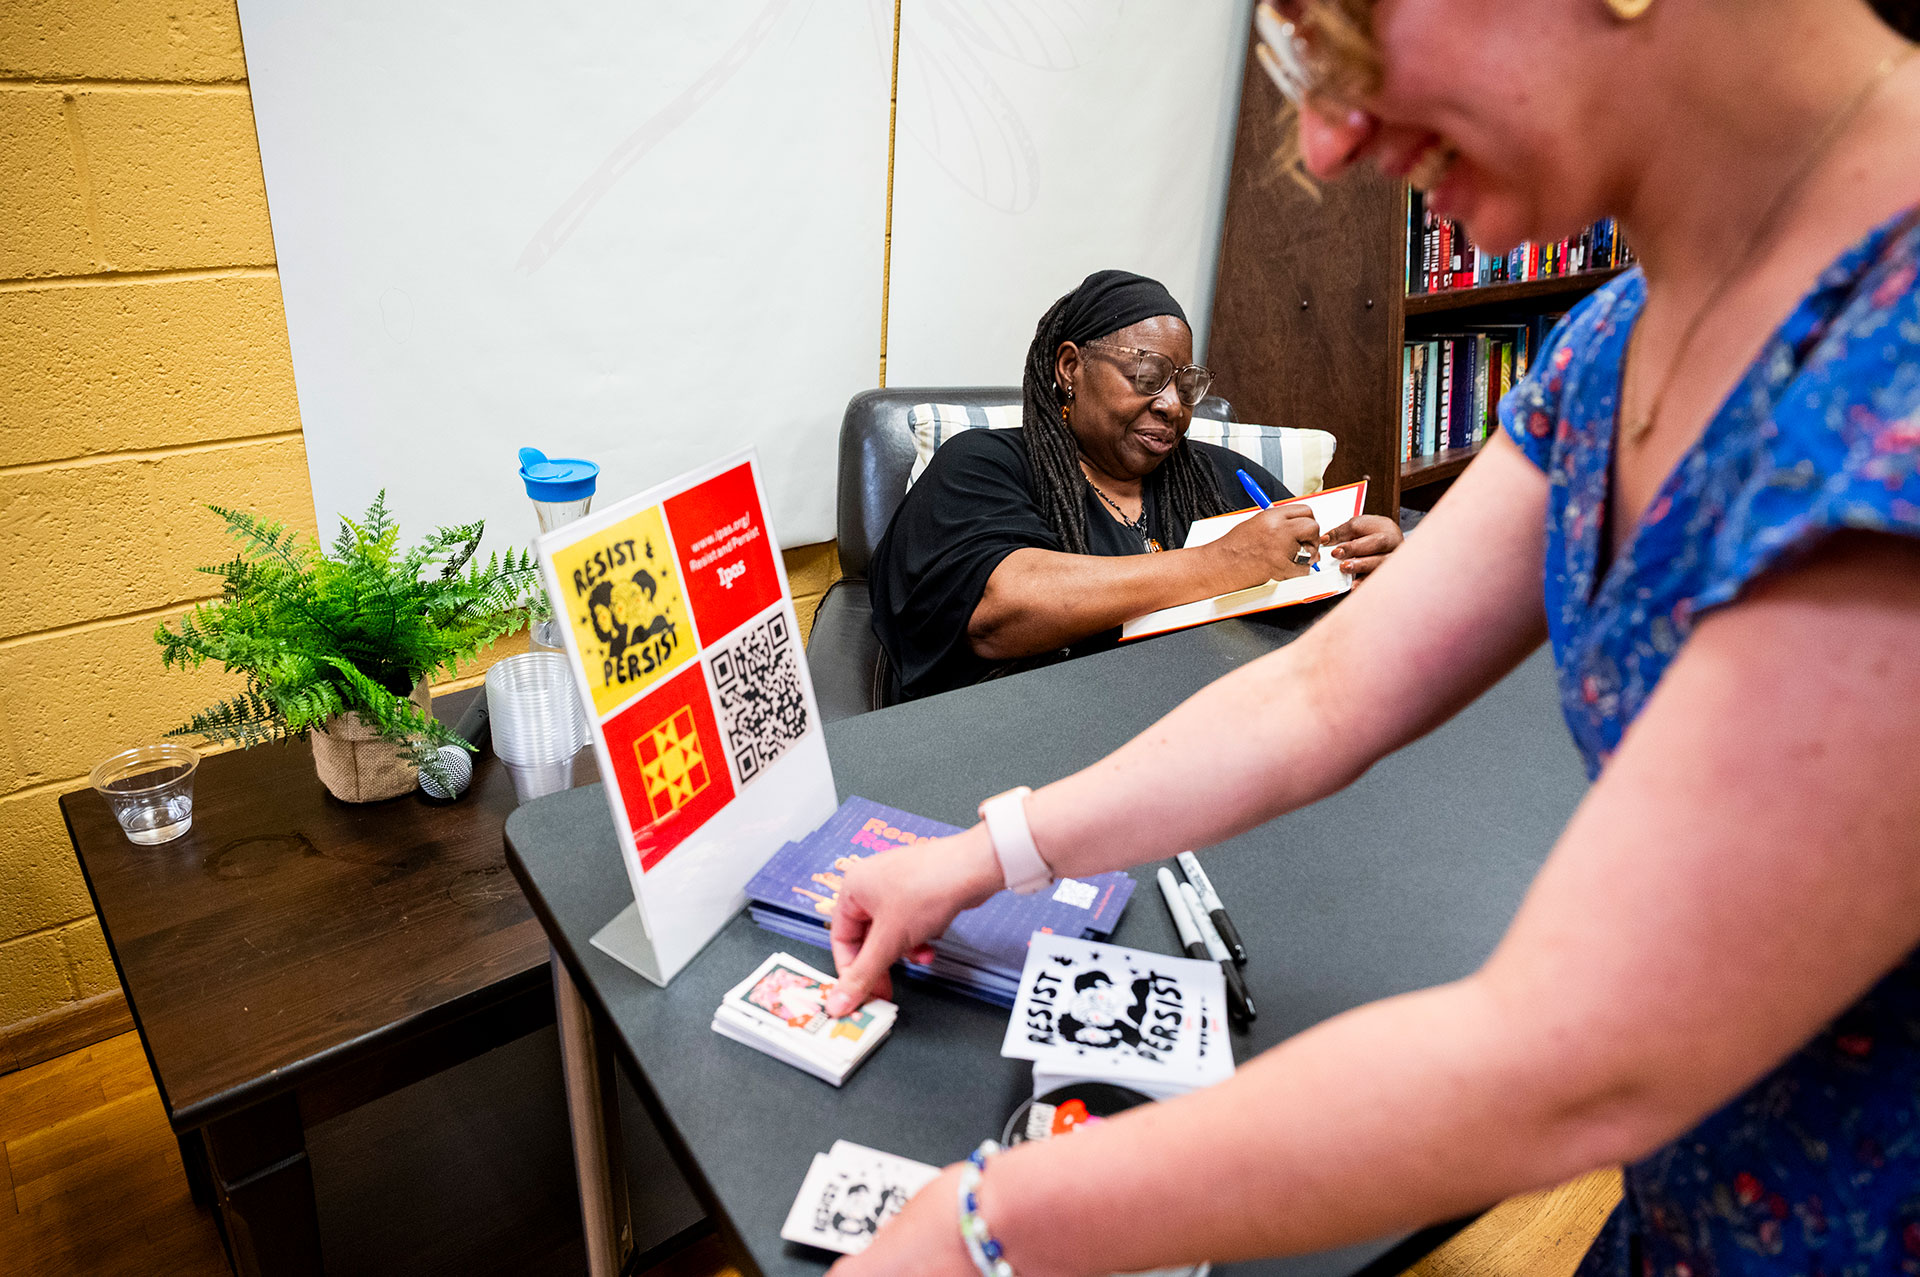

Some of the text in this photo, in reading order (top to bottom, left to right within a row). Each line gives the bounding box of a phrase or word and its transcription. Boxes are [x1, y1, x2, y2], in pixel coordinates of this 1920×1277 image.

[691, 510, 750, 553] www.ipas.org/
[574, 540, 635, 597] RESIST
[717, 560, 746, 589] Ipas
[604, 622, 679, 686] PERSIST
[1027, 971, 1061, 1045] RESIST
[1138, 971, 1183, 1064] PERSIST
